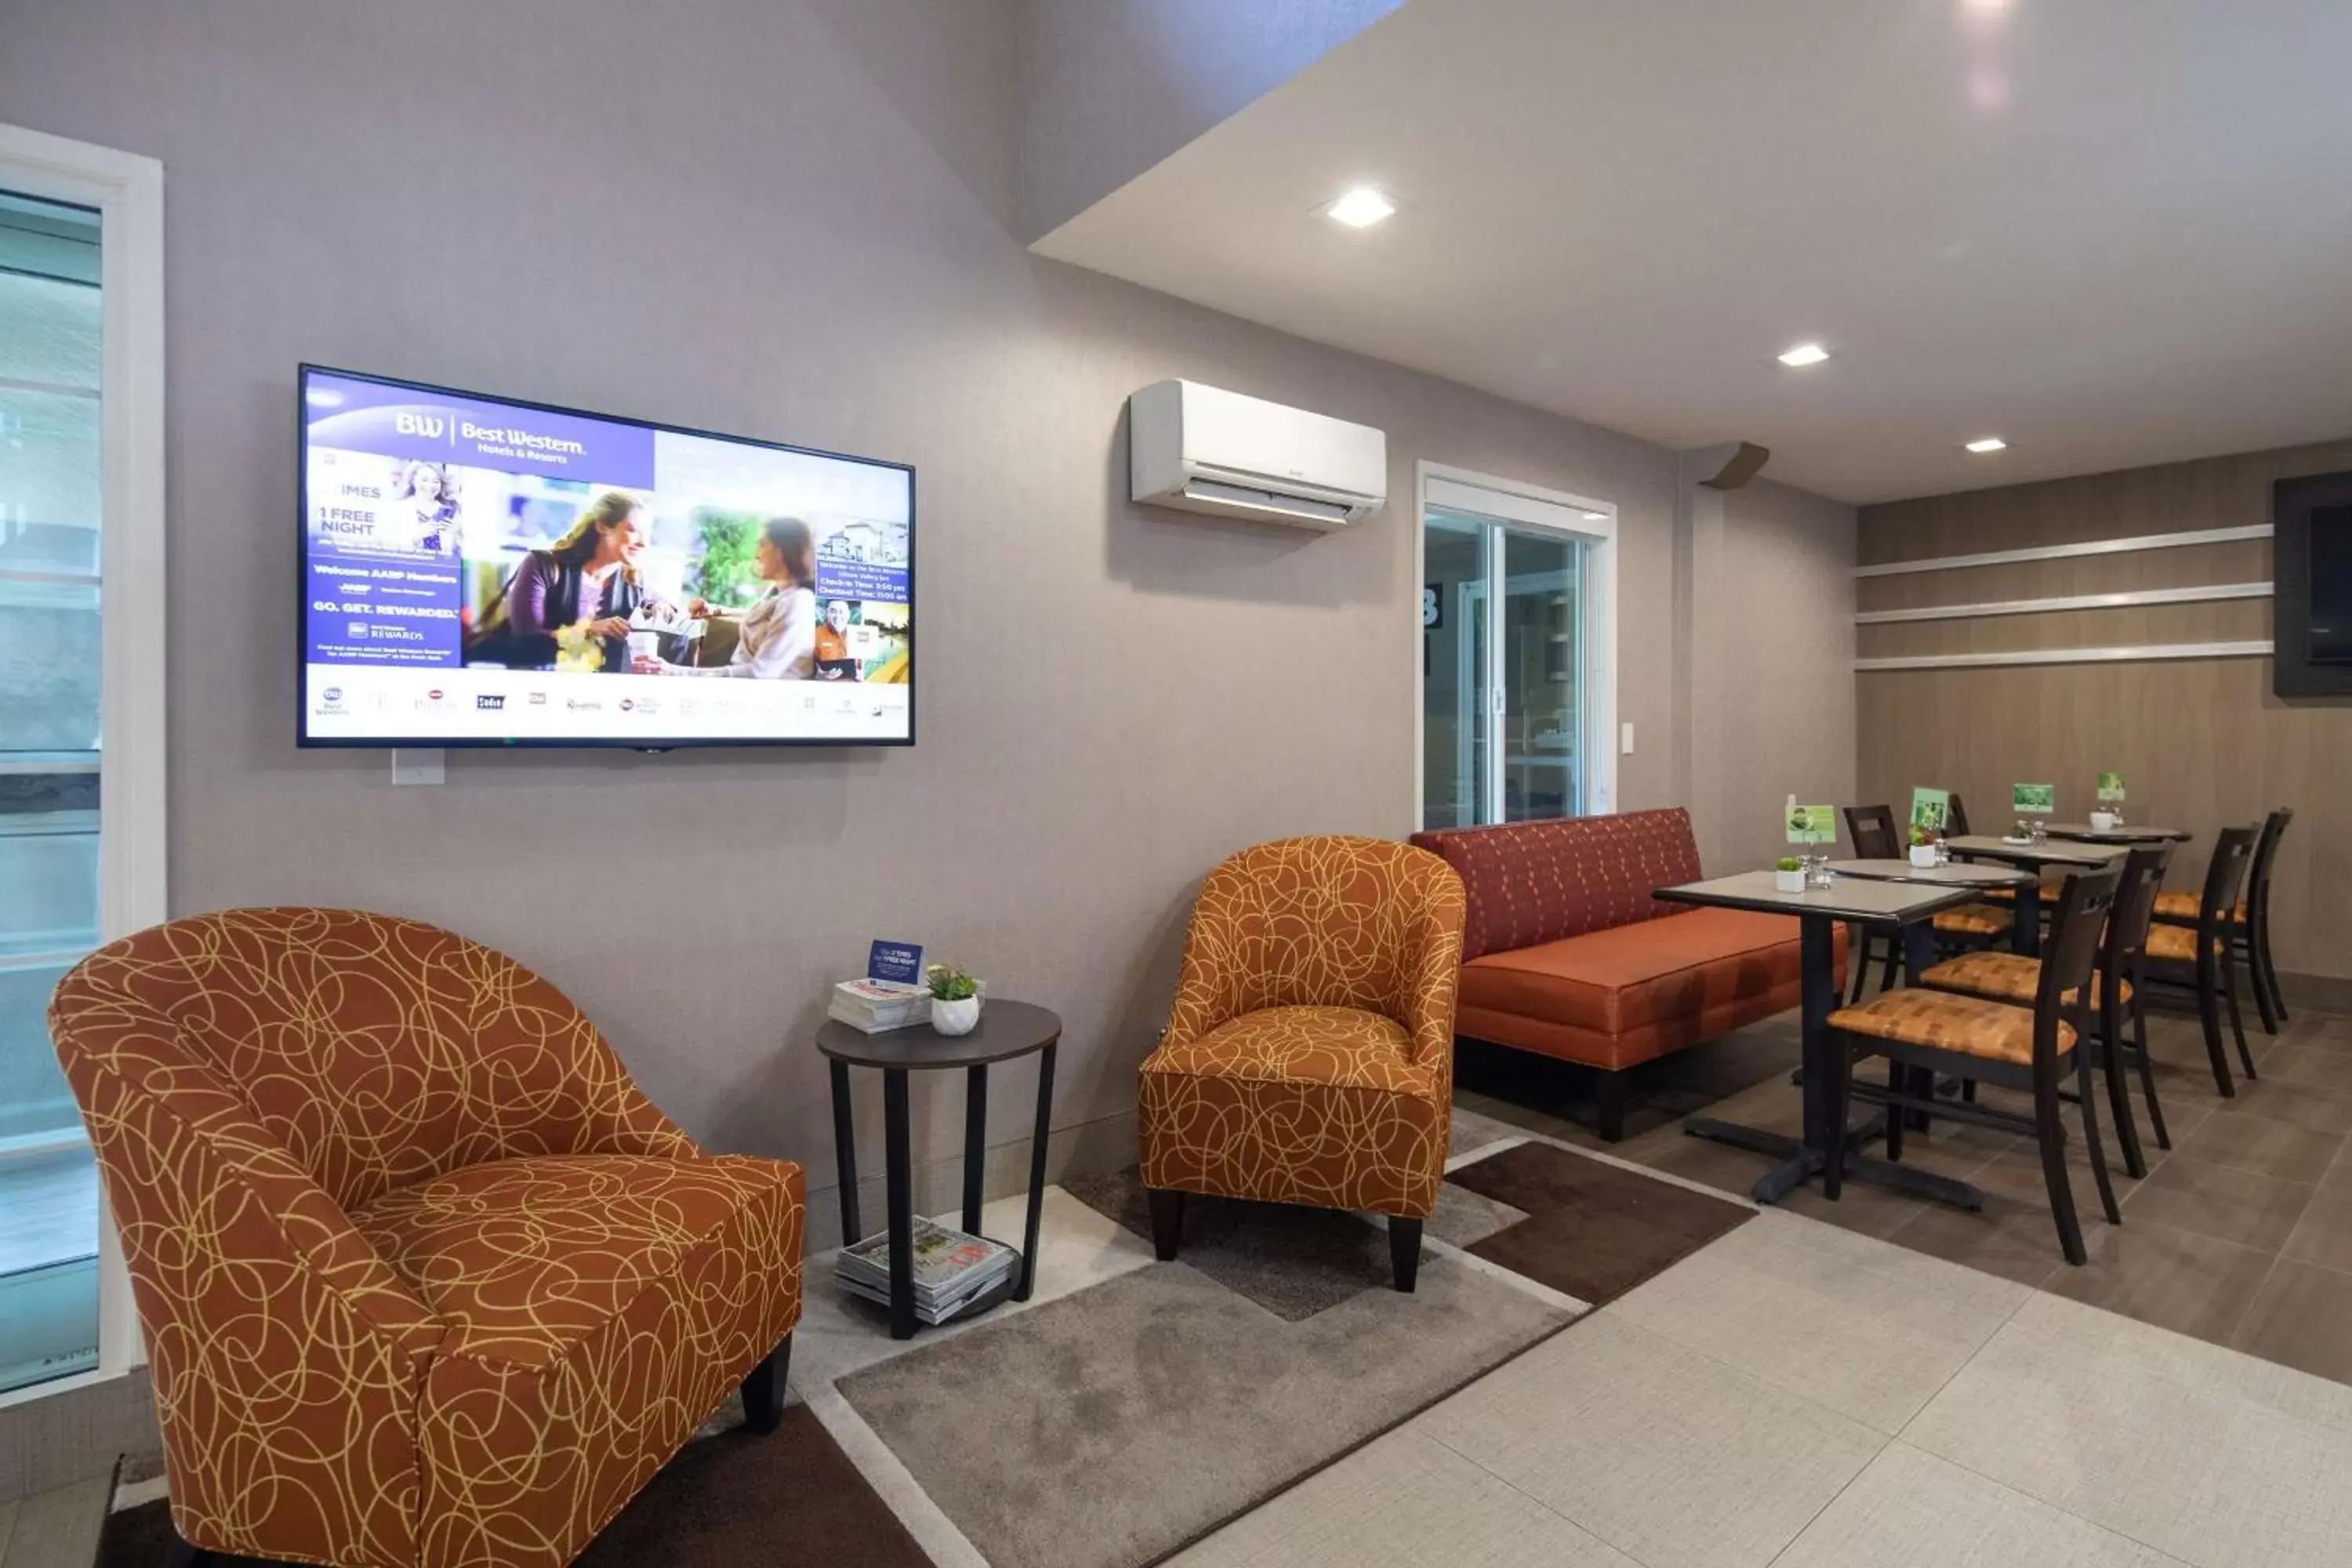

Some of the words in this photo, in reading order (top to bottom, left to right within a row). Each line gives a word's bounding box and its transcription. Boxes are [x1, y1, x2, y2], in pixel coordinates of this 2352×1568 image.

[396, 412, 444, 438] BW
[462, 422, 506, 443] Best
[477, 443, 514, 456] Hotels
[516, 448, 525, 458] &
[527, 449, 568, 464] Resorts
[319, 506, 327, 519] 1
[330, 507, 376, 523] FREE
[321, 519, 376, 535] NIGHT
[314, 601, 339, 612] GO.
[371, 630, 424, 641] REWARDS
